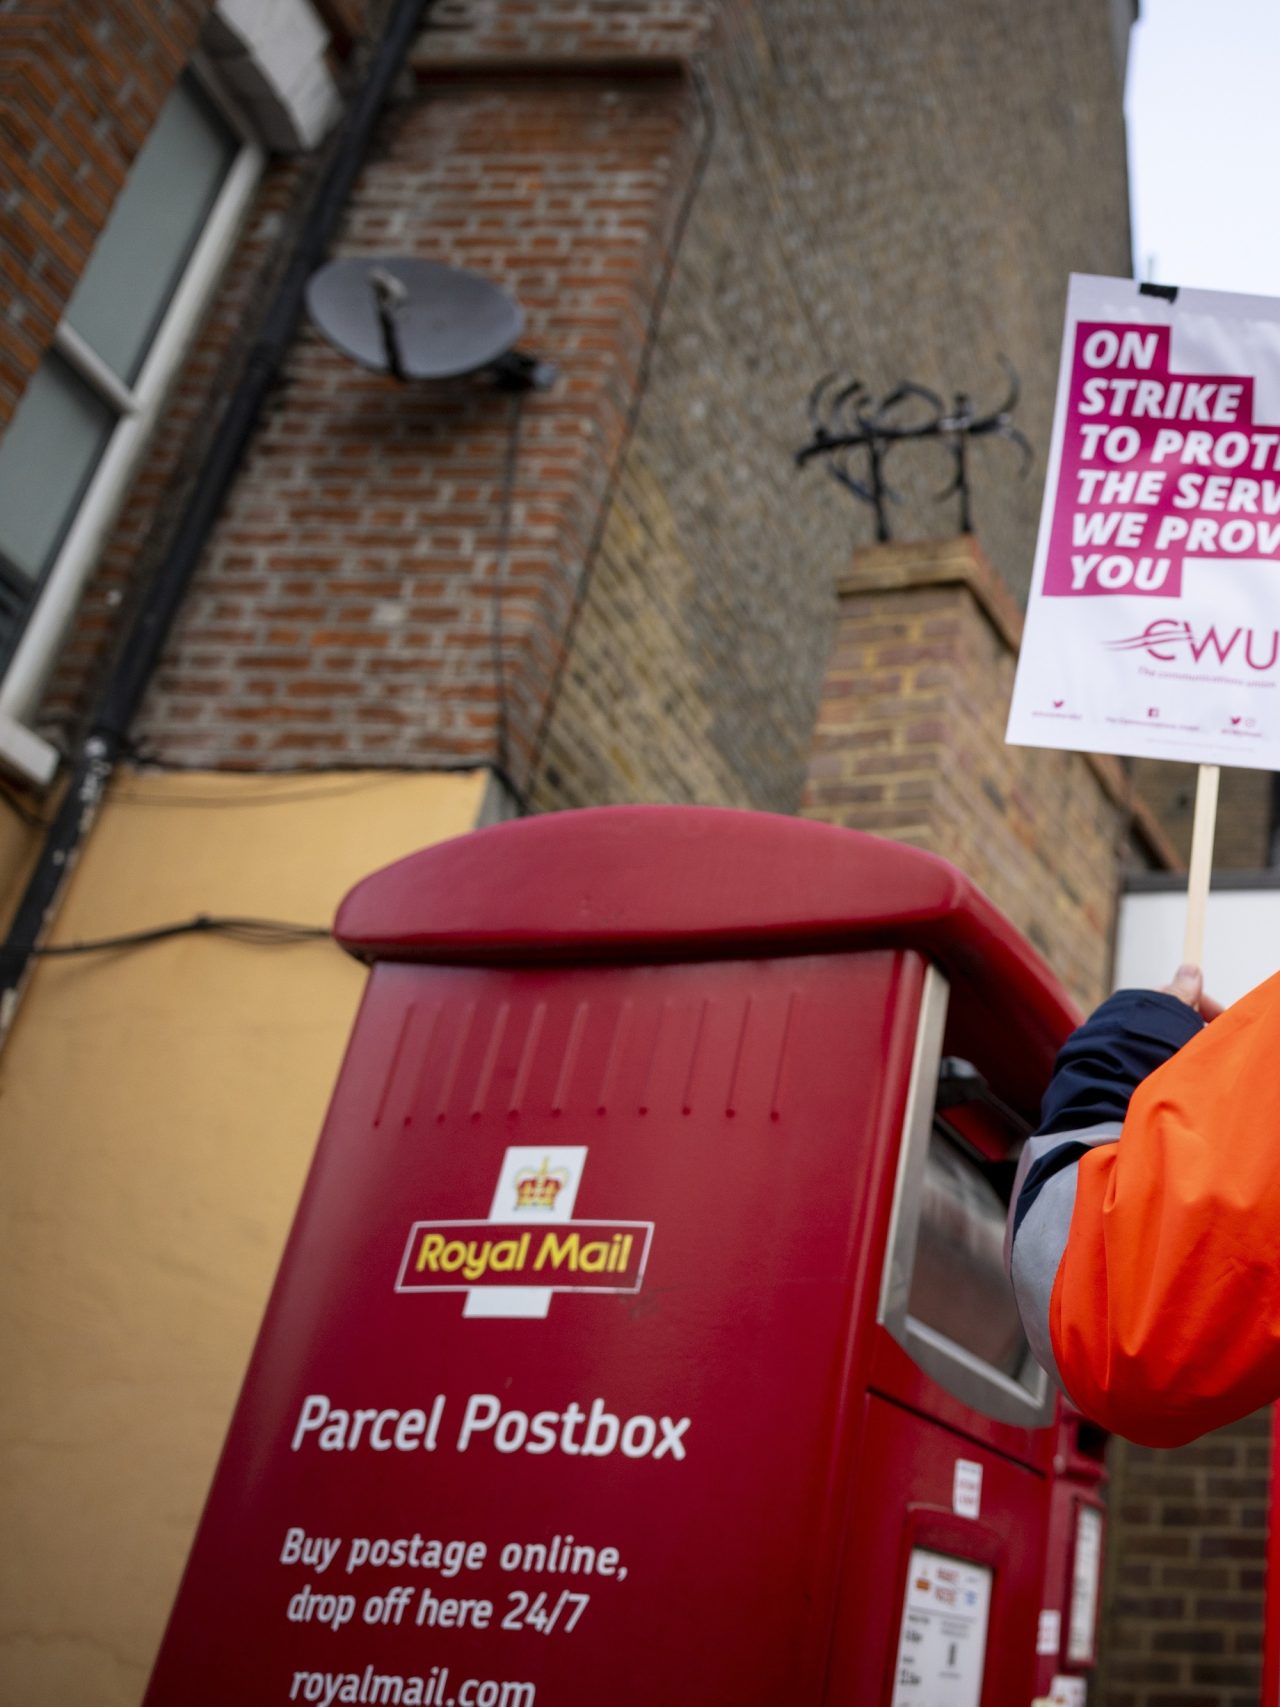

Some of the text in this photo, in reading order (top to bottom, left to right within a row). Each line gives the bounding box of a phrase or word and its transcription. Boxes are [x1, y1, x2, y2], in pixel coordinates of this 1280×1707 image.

[1082, 329, 1160, 370] ON
[1077, 377, 1243, 423] STRIKE
[1079, 424, 1141, 463] TO
[1076, 469, 1167, 505] THE
[1071, 512, 1148, 548] WE
[1070, 554, 1171, 590] YOU
[1141, 618, 1280, 671] CWU
[415, 1232, 633, 1281] Royal Mail
[290, 1393, 692, 1461] Parcel Postbox
[279, 1527, 629, 1582] Buy postage online,
[286, 1584, 591, 1635] drop off here 24/7
[289, 1664, 537, 1707] royalmail.com
